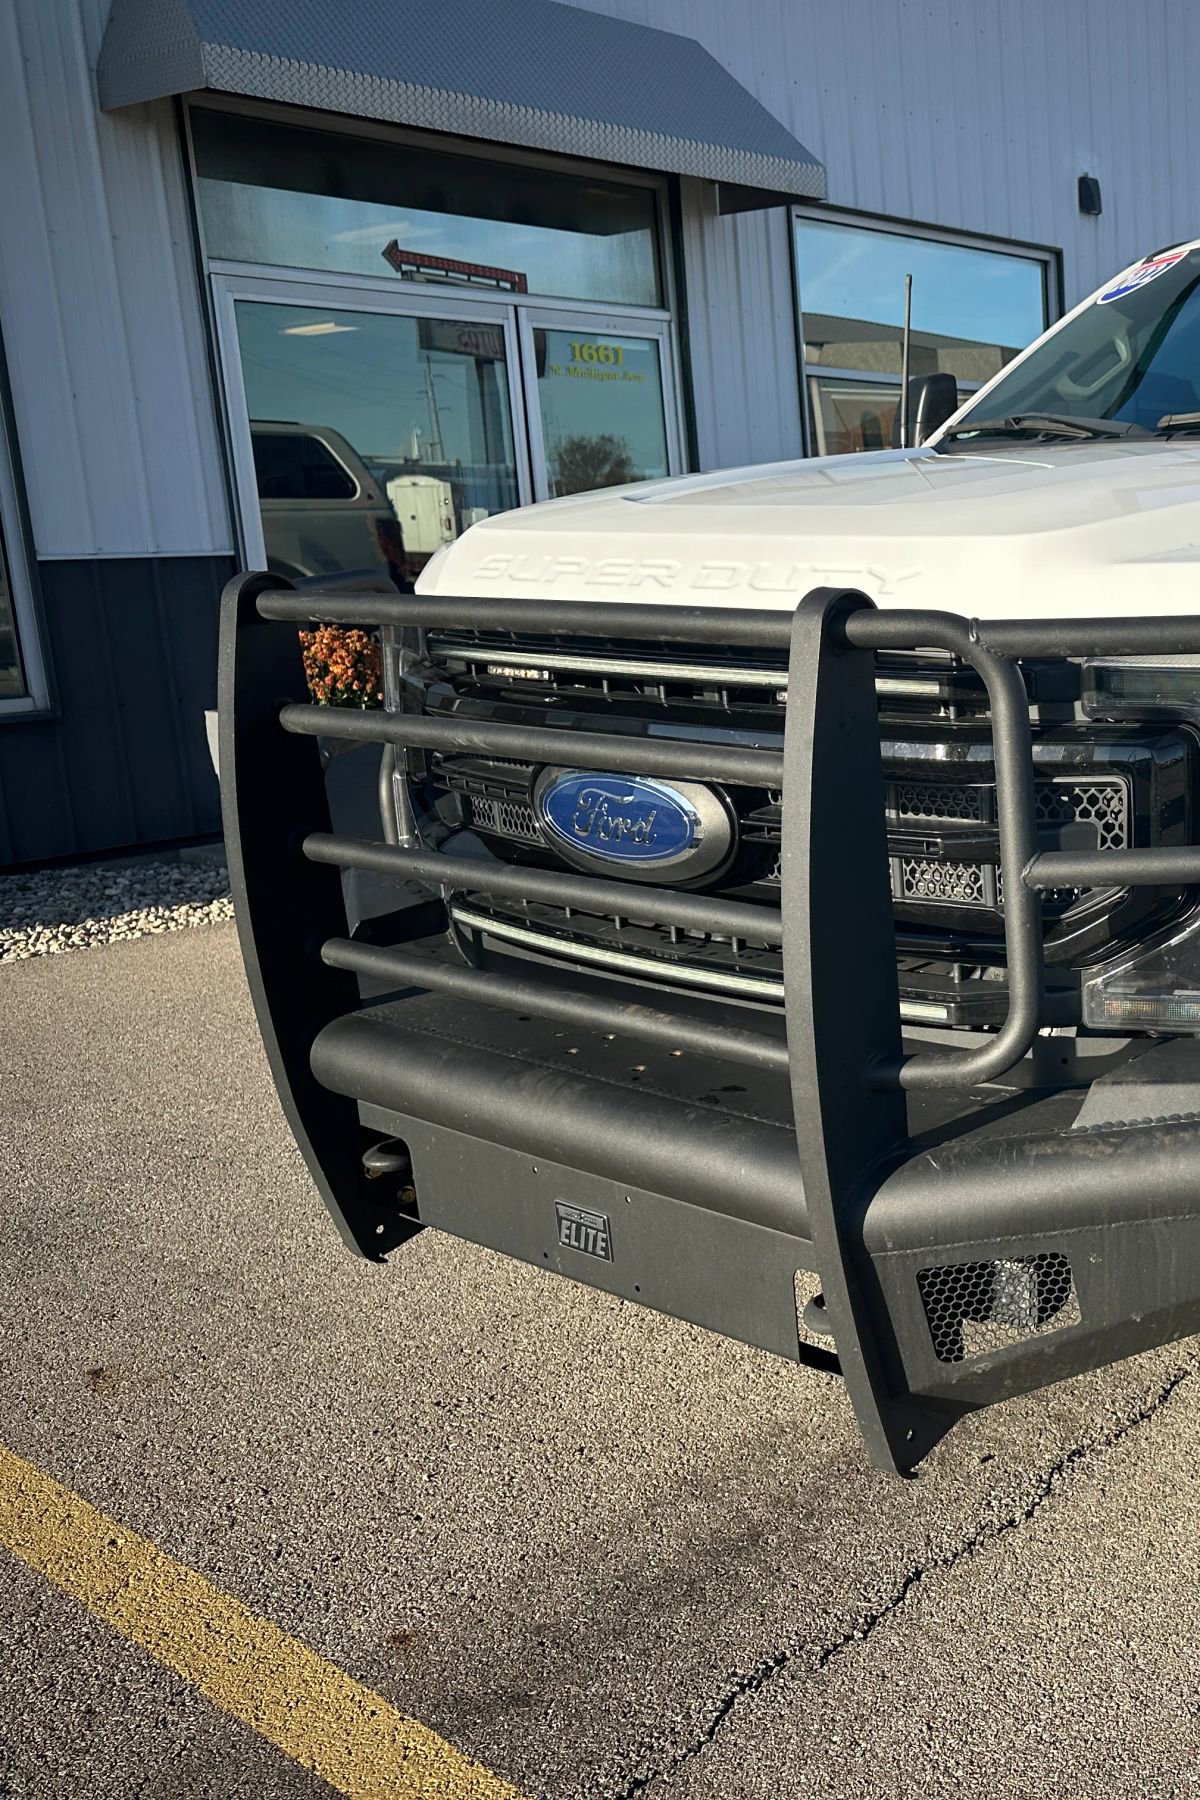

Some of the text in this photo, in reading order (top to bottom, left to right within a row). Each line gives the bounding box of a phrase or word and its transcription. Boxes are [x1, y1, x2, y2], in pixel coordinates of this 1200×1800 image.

[569, 341, 625, 366] 1661
[473, 553, 924, 595] SUPER DUTY
[573, 787, 658, 847] Ford
[560, 1219, 607, 1257] ELITE
